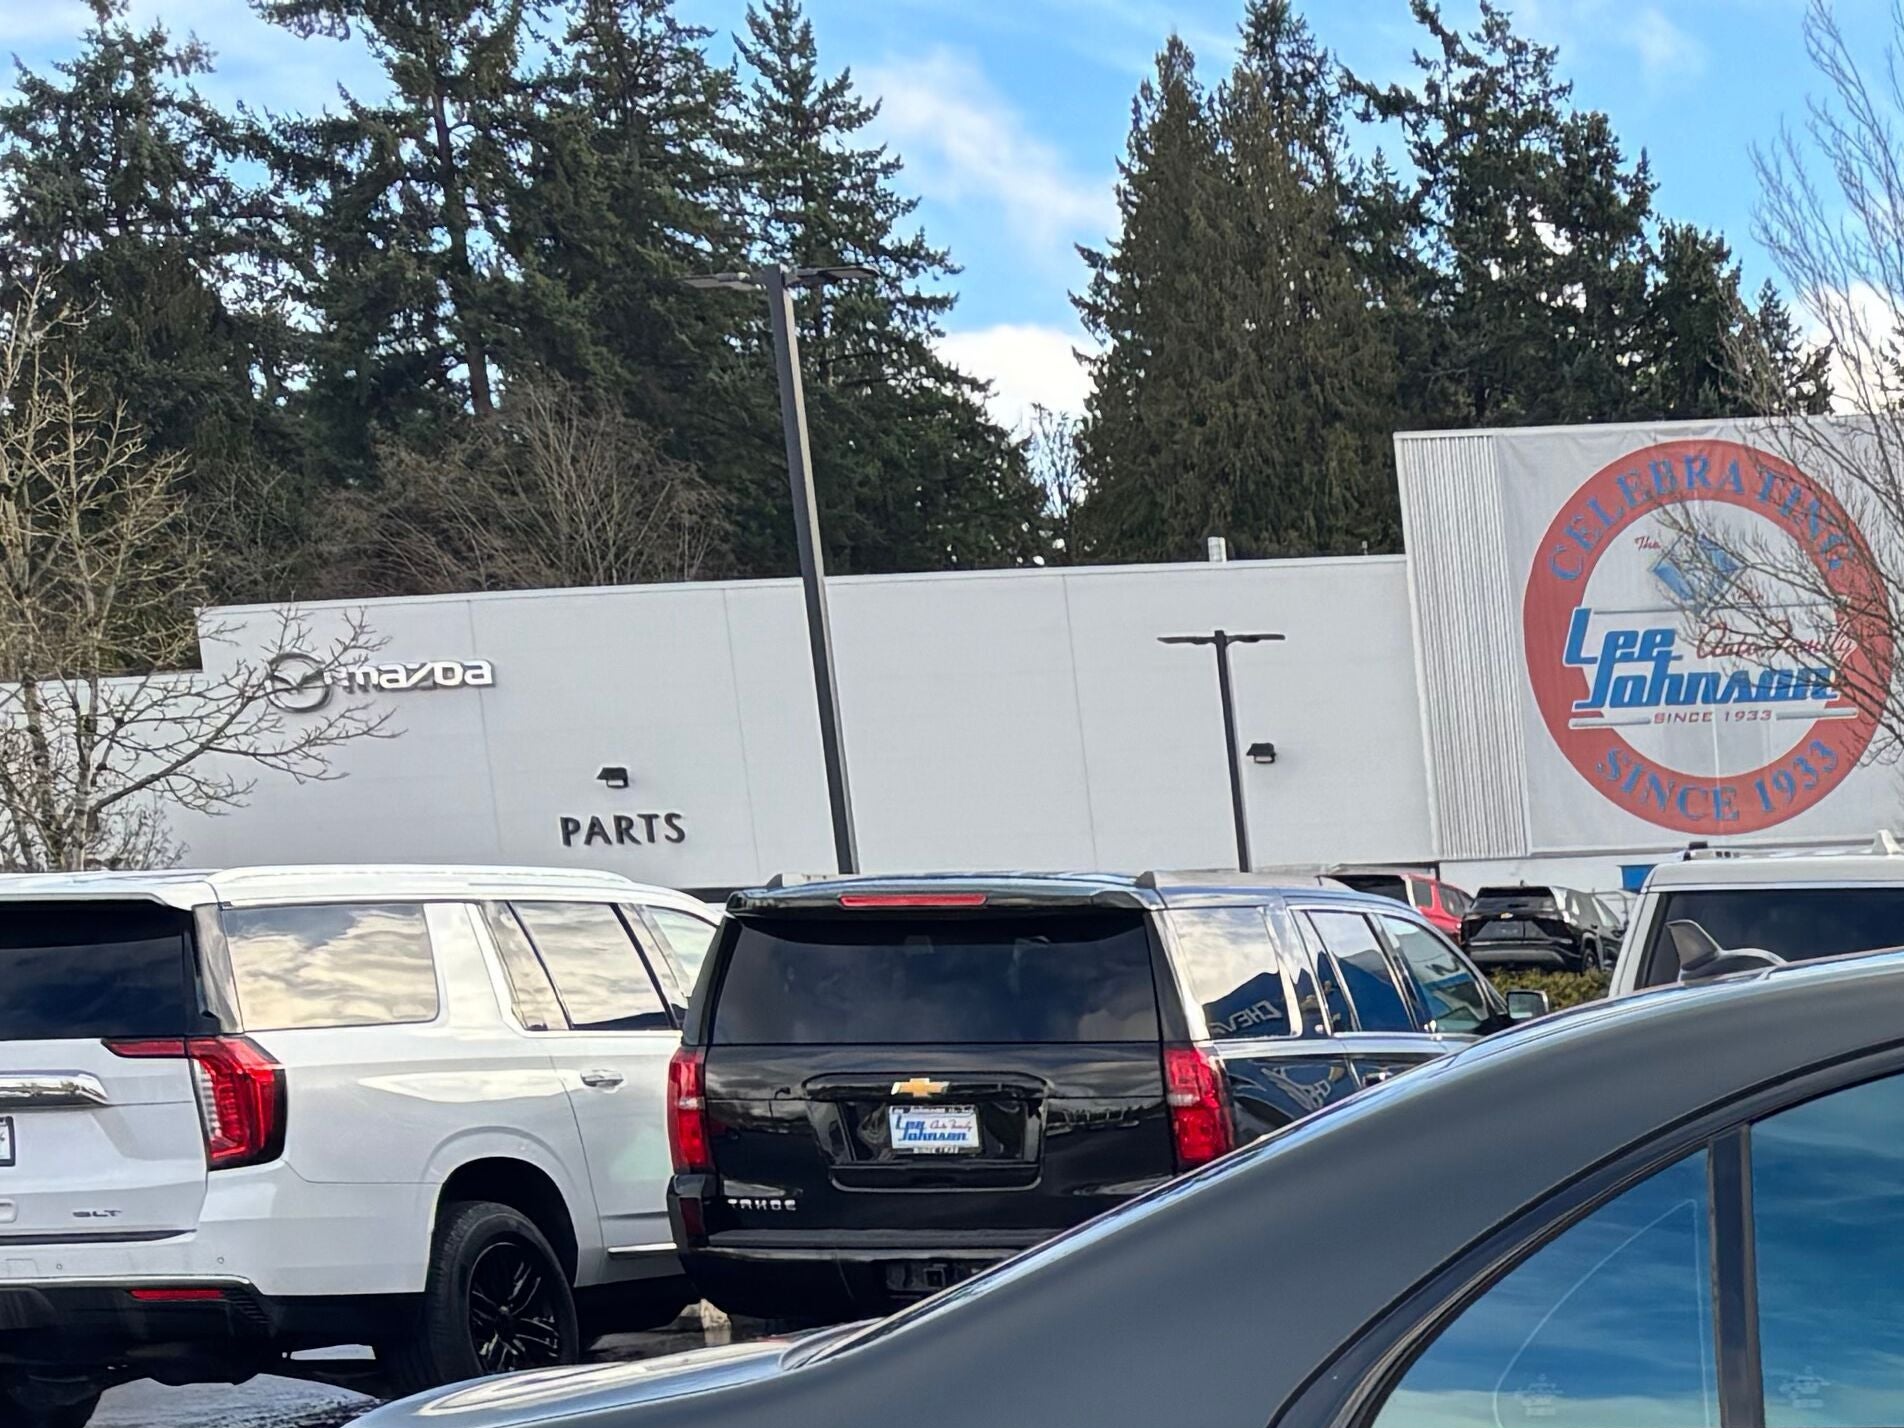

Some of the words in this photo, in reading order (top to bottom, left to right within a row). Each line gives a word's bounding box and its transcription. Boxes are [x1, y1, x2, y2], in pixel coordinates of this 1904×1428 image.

[1548, 455, 1855, 581] CELEBRATING
[1565, 609, 1683, 664] Lee
[336, 659, 492, 690] mazda
[1574, 655, 1840, 709] Johnson
[1654, 712, 1713, 724] SINCE
[1724, 710, 1773, 722] 1933
[1599, 746, 1741, 821] SINCE
[1757, 739, 1840, 814] 1933
[560, 812, 686, 847] PARTS
